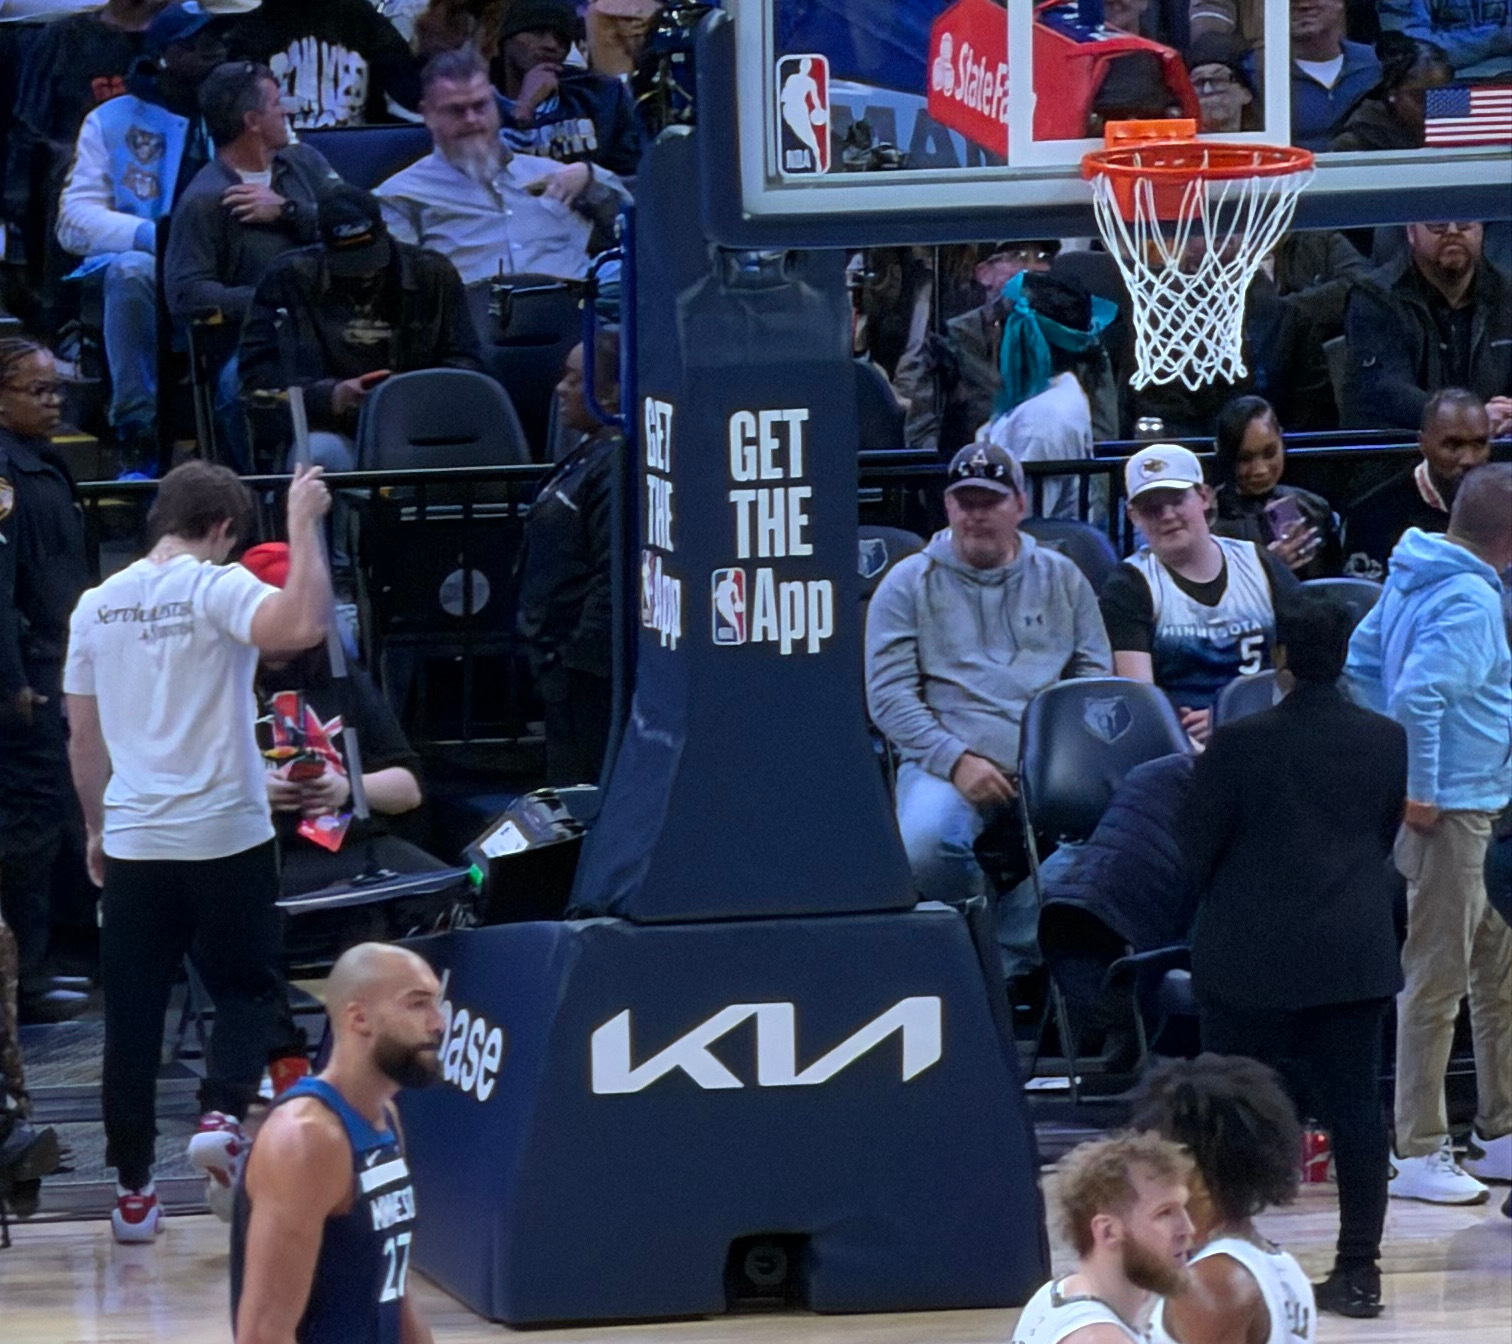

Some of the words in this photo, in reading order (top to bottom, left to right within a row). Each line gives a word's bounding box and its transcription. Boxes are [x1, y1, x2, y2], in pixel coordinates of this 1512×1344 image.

[644, 396, 674, 474] GET
[729, 408, 810, 482] GET
[646, 473, 675, 553] THE
[728, 486, 815, 559] THE
[751, 567, 834, 655] App
[1238, 635, 1265, 675] 5
[437, 968, 503, 1102] base
[591, 996, 942, 1094] KIA
[379, 1231, 413, 1304] 27
